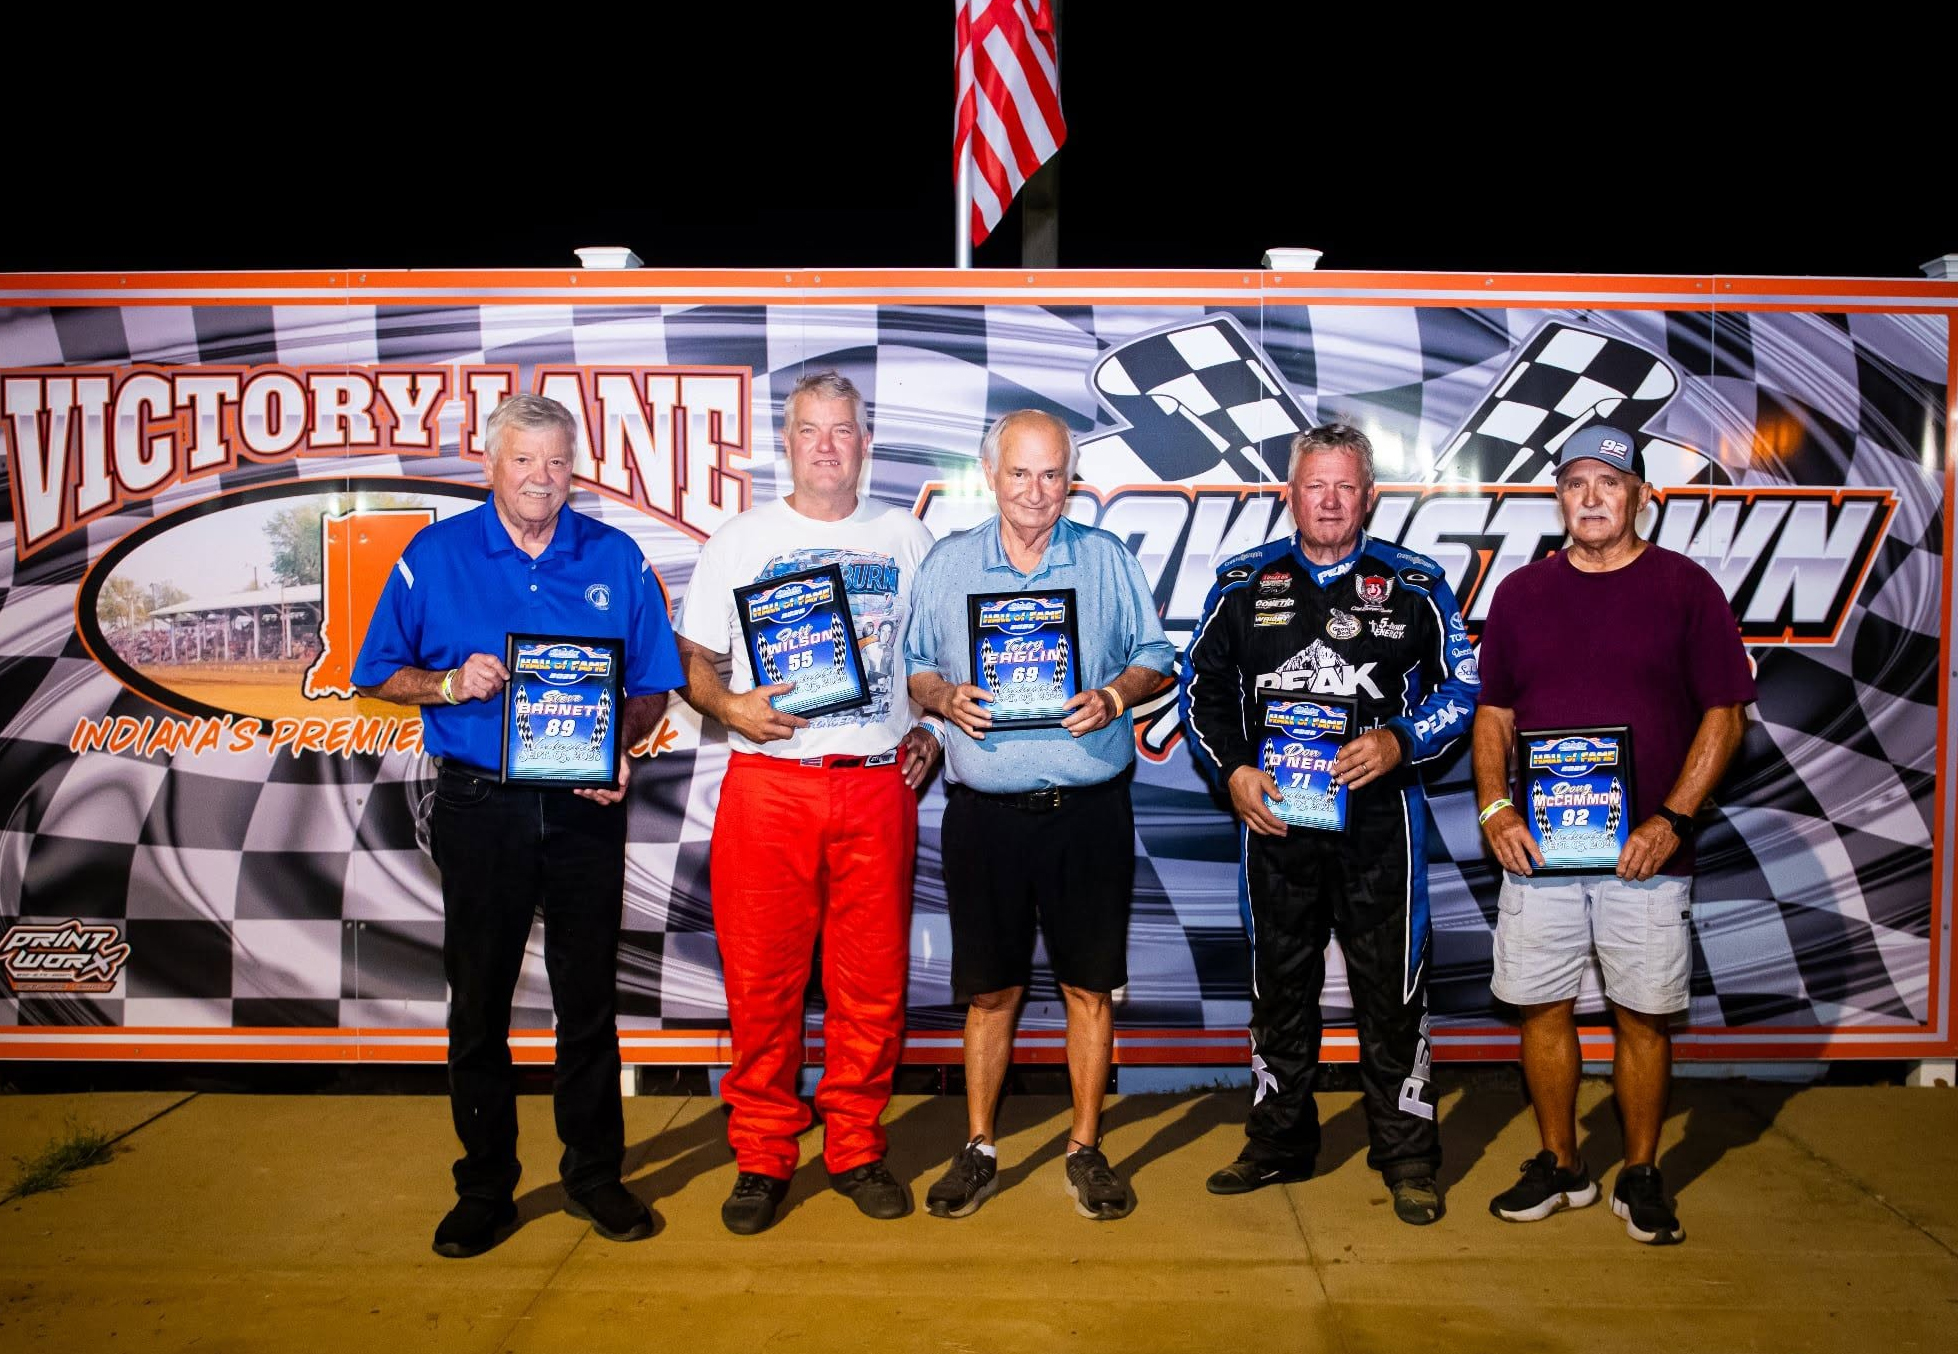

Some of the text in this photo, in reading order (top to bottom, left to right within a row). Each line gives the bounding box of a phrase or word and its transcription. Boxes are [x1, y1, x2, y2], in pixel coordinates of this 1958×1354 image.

[1602, 439, 1628, 456] 92
[2, 368, 450, 552] VICTORY
[752, 601, 780, 617] HALL
[783, 597, 795, 609] of
[797, 587, 831, 606] FAME
[983, 609, 1063, 624] HALL of FAME
[775, 623, 814, 642] Jeff
[1374, 629, 1405, 640] ENERGY
[766, 629, 834, 656] WILSON
[1003, 636, 1045, 653] Terry
[520, 657, 608, 673] HALL of FAME
[788, 650, 814, 671] 55
[985, 650, 1061, 664] EAGLIN
[1012, 666, 1039, 683] 69
[538, 689, 584, 704] Steve
[517, 703, 608, 717] BARNETT
[545, 719, 576, 737] 89
[1268, 713, 1295, 726] HALL
[1297, 716, 1310, 726] of
[1312, 717, 1345, 731] FAME
[1414, 699, 1469, 741] PEAK
[71, 715, 258, 758] INDIANA'S
[1283, 742, 1321, 758] Don
[1533, 750, 1615, 765] HALL of FAME
[1290, 772, 1312, 790] 71
[1551, 781, 1593, 797] Doug
[1534, 792, 1621, 807] McCAMMON
[1561, 808, 1590, 827] 92
[2, 928, 112, 953] PRINT
[13, 949, 121, 975] WORX
